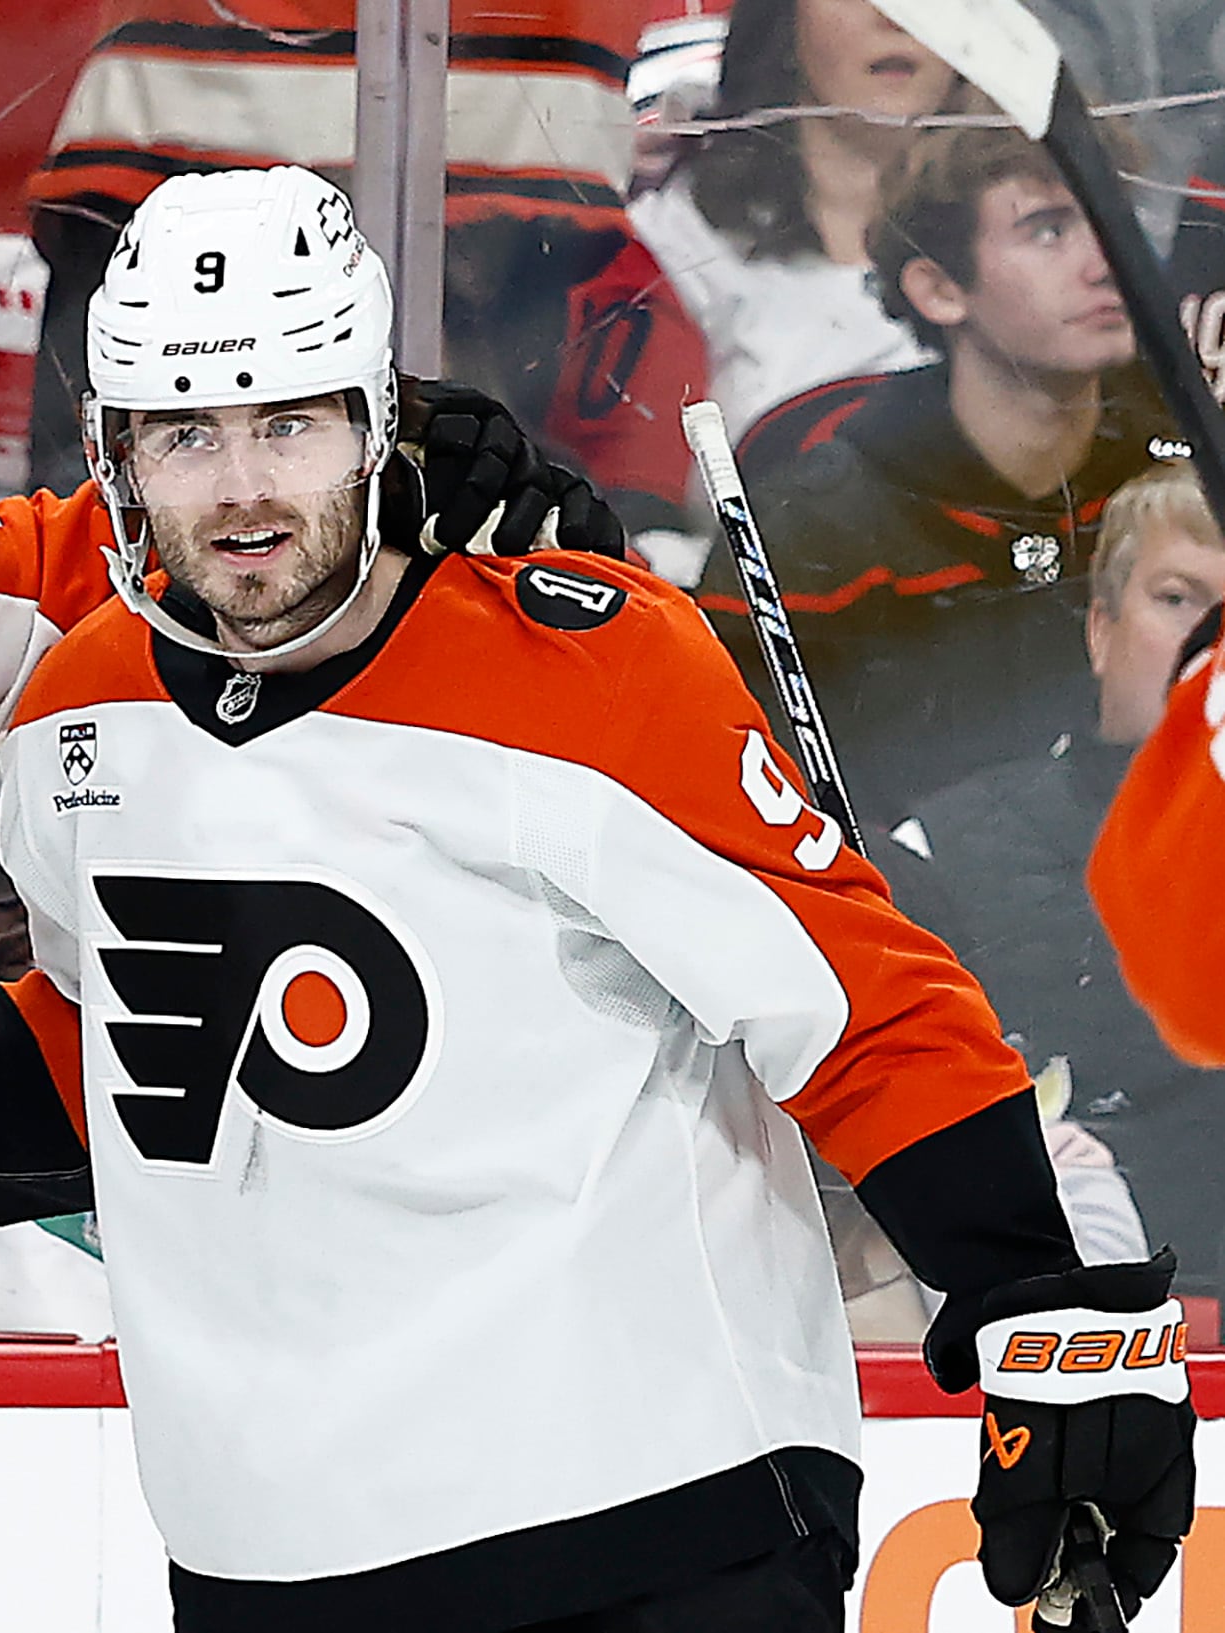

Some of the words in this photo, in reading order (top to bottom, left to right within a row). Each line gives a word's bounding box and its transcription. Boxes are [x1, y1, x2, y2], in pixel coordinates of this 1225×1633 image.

[193, 251, 226, 294] 9
[528, 568, 618, 614] 1
[740, 728, 843, 871] 9
